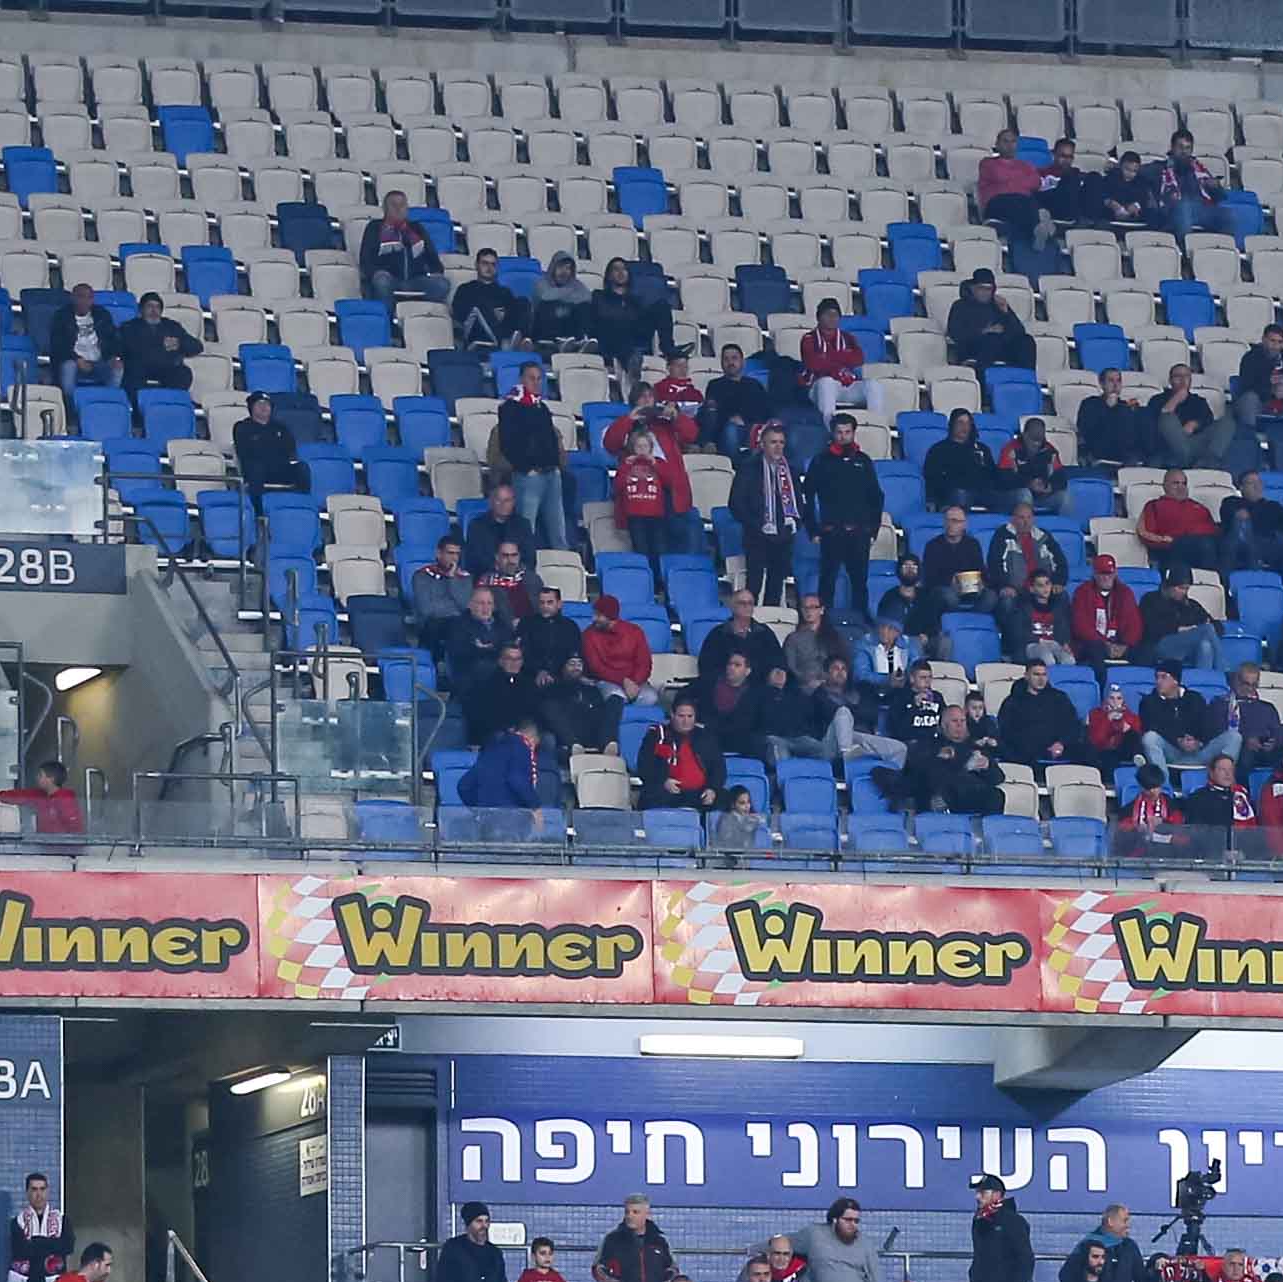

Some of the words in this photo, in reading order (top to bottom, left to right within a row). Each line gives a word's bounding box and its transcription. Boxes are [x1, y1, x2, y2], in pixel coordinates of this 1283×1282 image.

[341, 903, 638, 969] Winner
[737, 912, 1024, 976] Winner
[461, 1117, 704, 1185] חיפה
[747, 1123, 1107, 1191] העירוני
